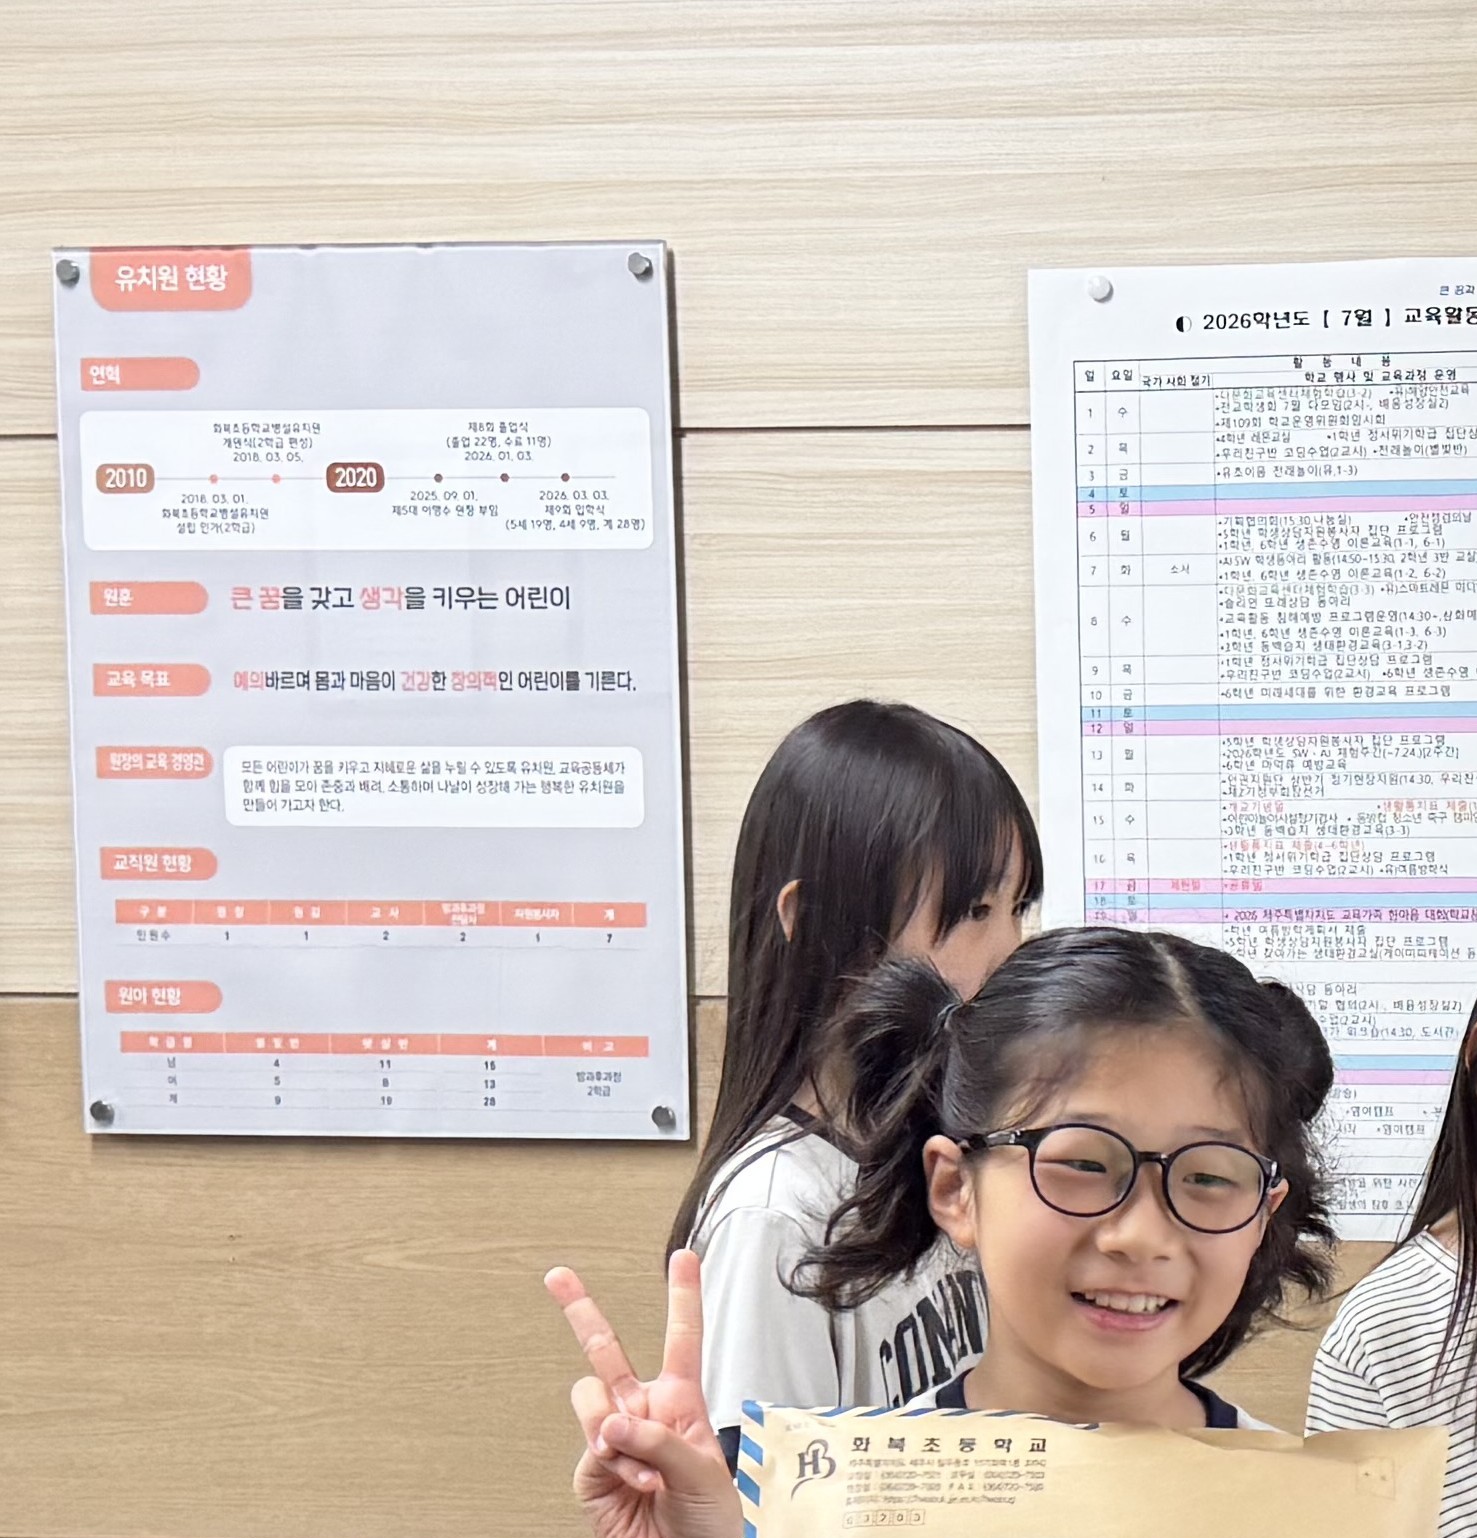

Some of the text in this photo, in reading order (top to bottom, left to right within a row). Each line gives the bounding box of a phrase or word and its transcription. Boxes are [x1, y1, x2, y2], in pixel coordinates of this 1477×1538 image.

[115, 264, 228, 292] 유치원 현황
[1203, 310, 1311, 331] 2026학년도
[1341, 308, 1372, 327] 7월
[468, 421, 528, 433] 제8회 졸업식
[446, 436, 551, 448] (졸업 22명, 수료 11명)
[232, 452, 304, 463] 2018. 03. 05.
[498, 451, 514, 462] 01.
[517, 451, 534, 462] 03.
[105, 467, 147, 488] 2010
[335, 467, 379, 488] 2020
[181, 494, 249, 504] 2018. 03. 01.
[410, 490, 440, 501] 2025.
[463, 490, 479, 501] 01.
[572, 490, 589, 501] 03.
[592, 490, 610, 501] 03.
[545, 504, 605, 516] 제9회 입학식
[505, 519, 527, 531] (5세
[531, 519, 556, 531] 19명,
[559, 519, 576, 531] 4세
[579, 519, 600, 531] 9명,
[616, 519, 646, 531] 28명)
[1090, 531, 1097, 542] 6
[230, 586, 570, 610] 큰 꿈을 갖고 생각을 키우는 어린이
[107, 670, 171, 688] 교육 목표
[233, 670, 637, 692] 예의바르며 몸과 마음이 건강한 창의적인 어린이를 기른다.
[241, 760, 263, 774] 모든
[266, 760, 309, 774] 어린이가
[312, 760, 333, 774] 꿈을
[338, 760, 370, 774] 키우고
[445, 760, 466, 775] 누릴
[470, 760, 481, 774] 수
[484, 760, 517, 775] 있도록
[243, 779, 265, 793] 함께
[269, 779, 291, 793] 힘을
[295, 779, 317, 793] 모아
[388, 779, 433, 793] 소통하며
[437, 779, 472, 794] 나날이
[514, 780, 537, 794] 가는
[541, 780, 575, 794] 행복한
[243, 798, 345, 812] 만들어 가고자 한다.
[113, 853, 192, 873] 교직원 현황
[118, 987, 181, 1006] 원아 현황
